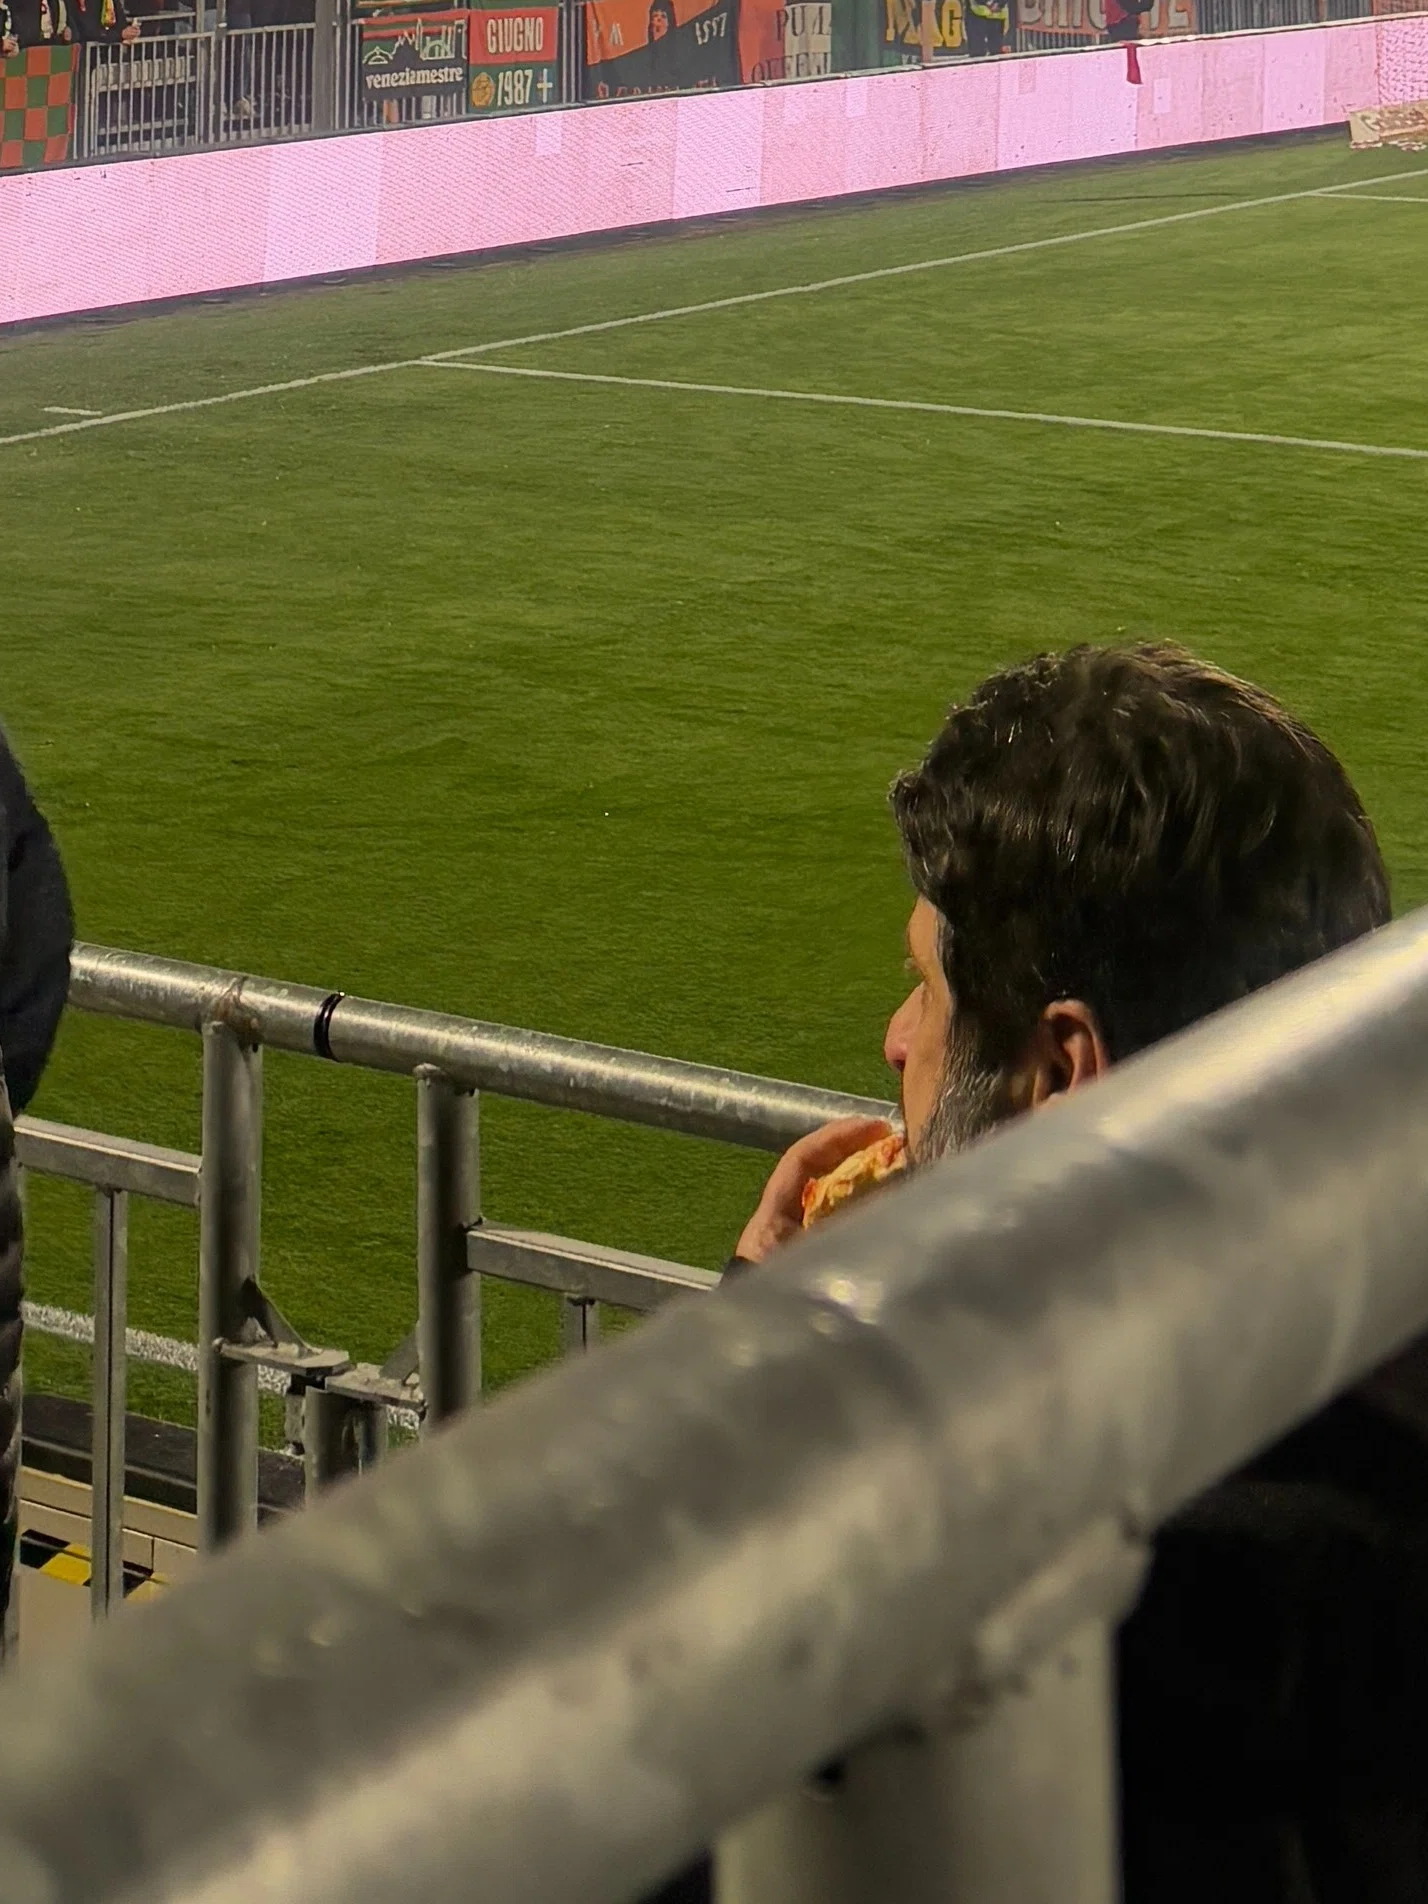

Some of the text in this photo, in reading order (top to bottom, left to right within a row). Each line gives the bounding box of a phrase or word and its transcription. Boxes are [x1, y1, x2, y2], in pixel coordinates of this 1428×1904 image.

[486, 16, 545, 54] GIUGNO
[365, 65, 464, 90] veneziamestre
[497, 67, 533, 107] 1987
